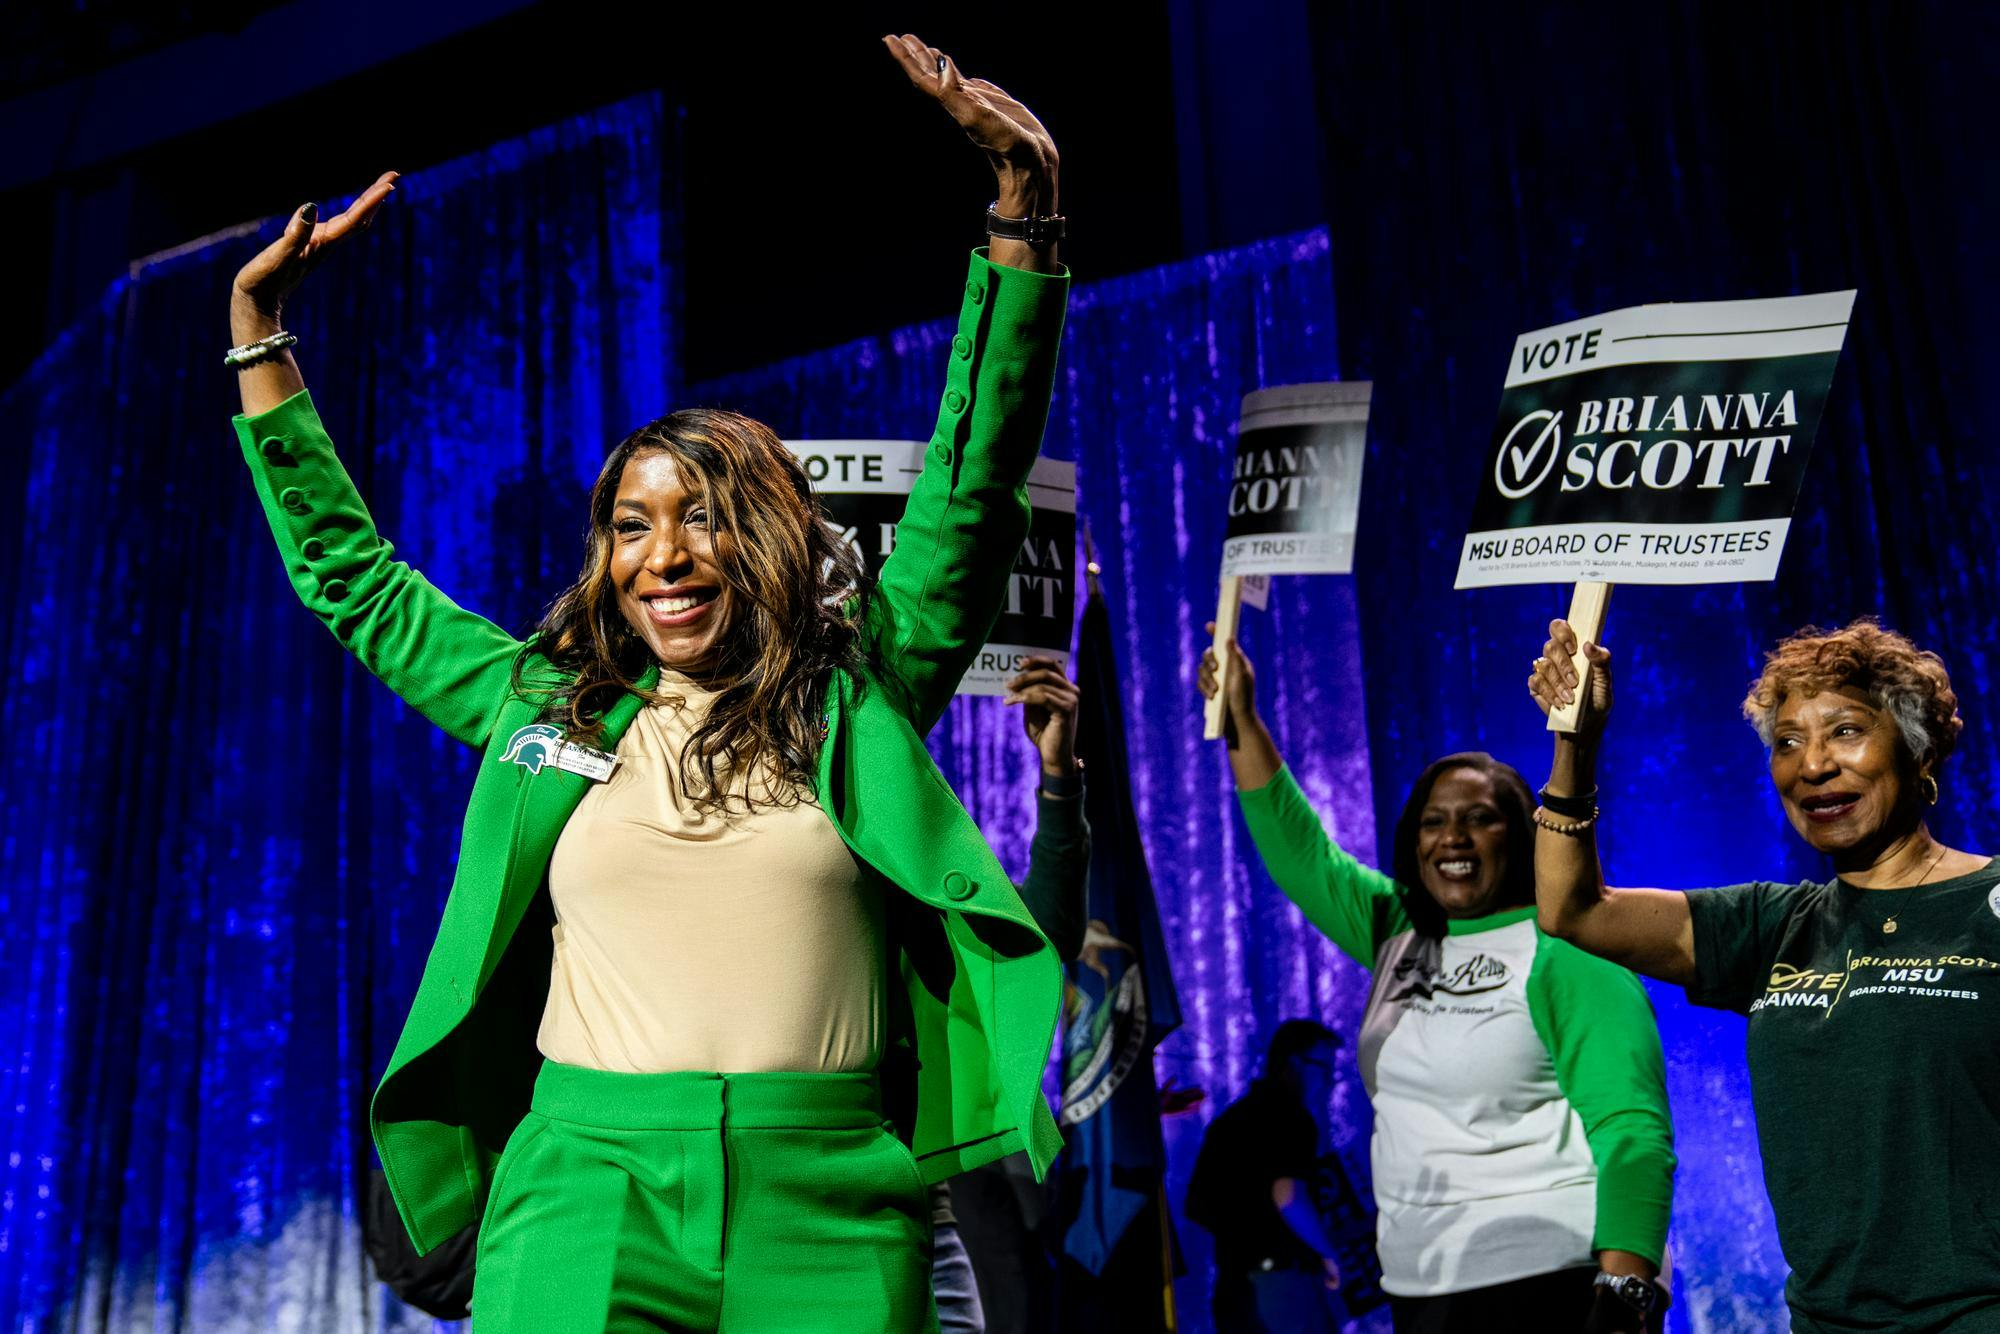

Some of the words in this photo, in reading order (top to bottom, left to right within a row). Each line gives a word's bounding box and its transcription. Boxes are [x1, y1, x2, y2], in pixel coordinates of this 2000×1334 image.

[1521, 328, 1603, 374] VOTE
[1573, 389, 1799, 437] BRIANNA
[1559, 434, 1792, 492] SCOTT
[1227, 542, 1246, 559] OF
[1469, 539, 1508, 561] MSU
[1511, 534, 1585, 557] BOARD
[1594, 533, 1631, 554] OF
[1640, 530, 1771, 555] TRUSTEES
[1850, 956, 1932, 972] BRIANNA
[1936, 954, 2000, 969] SCOTT
[1882, 968, 1945, 983] MSU
[1849, 985, 1887, 998] BOARD
[1890, 985, 1907, 995] OF
[1909, 986, 1979, 1000] TRUSTEES
